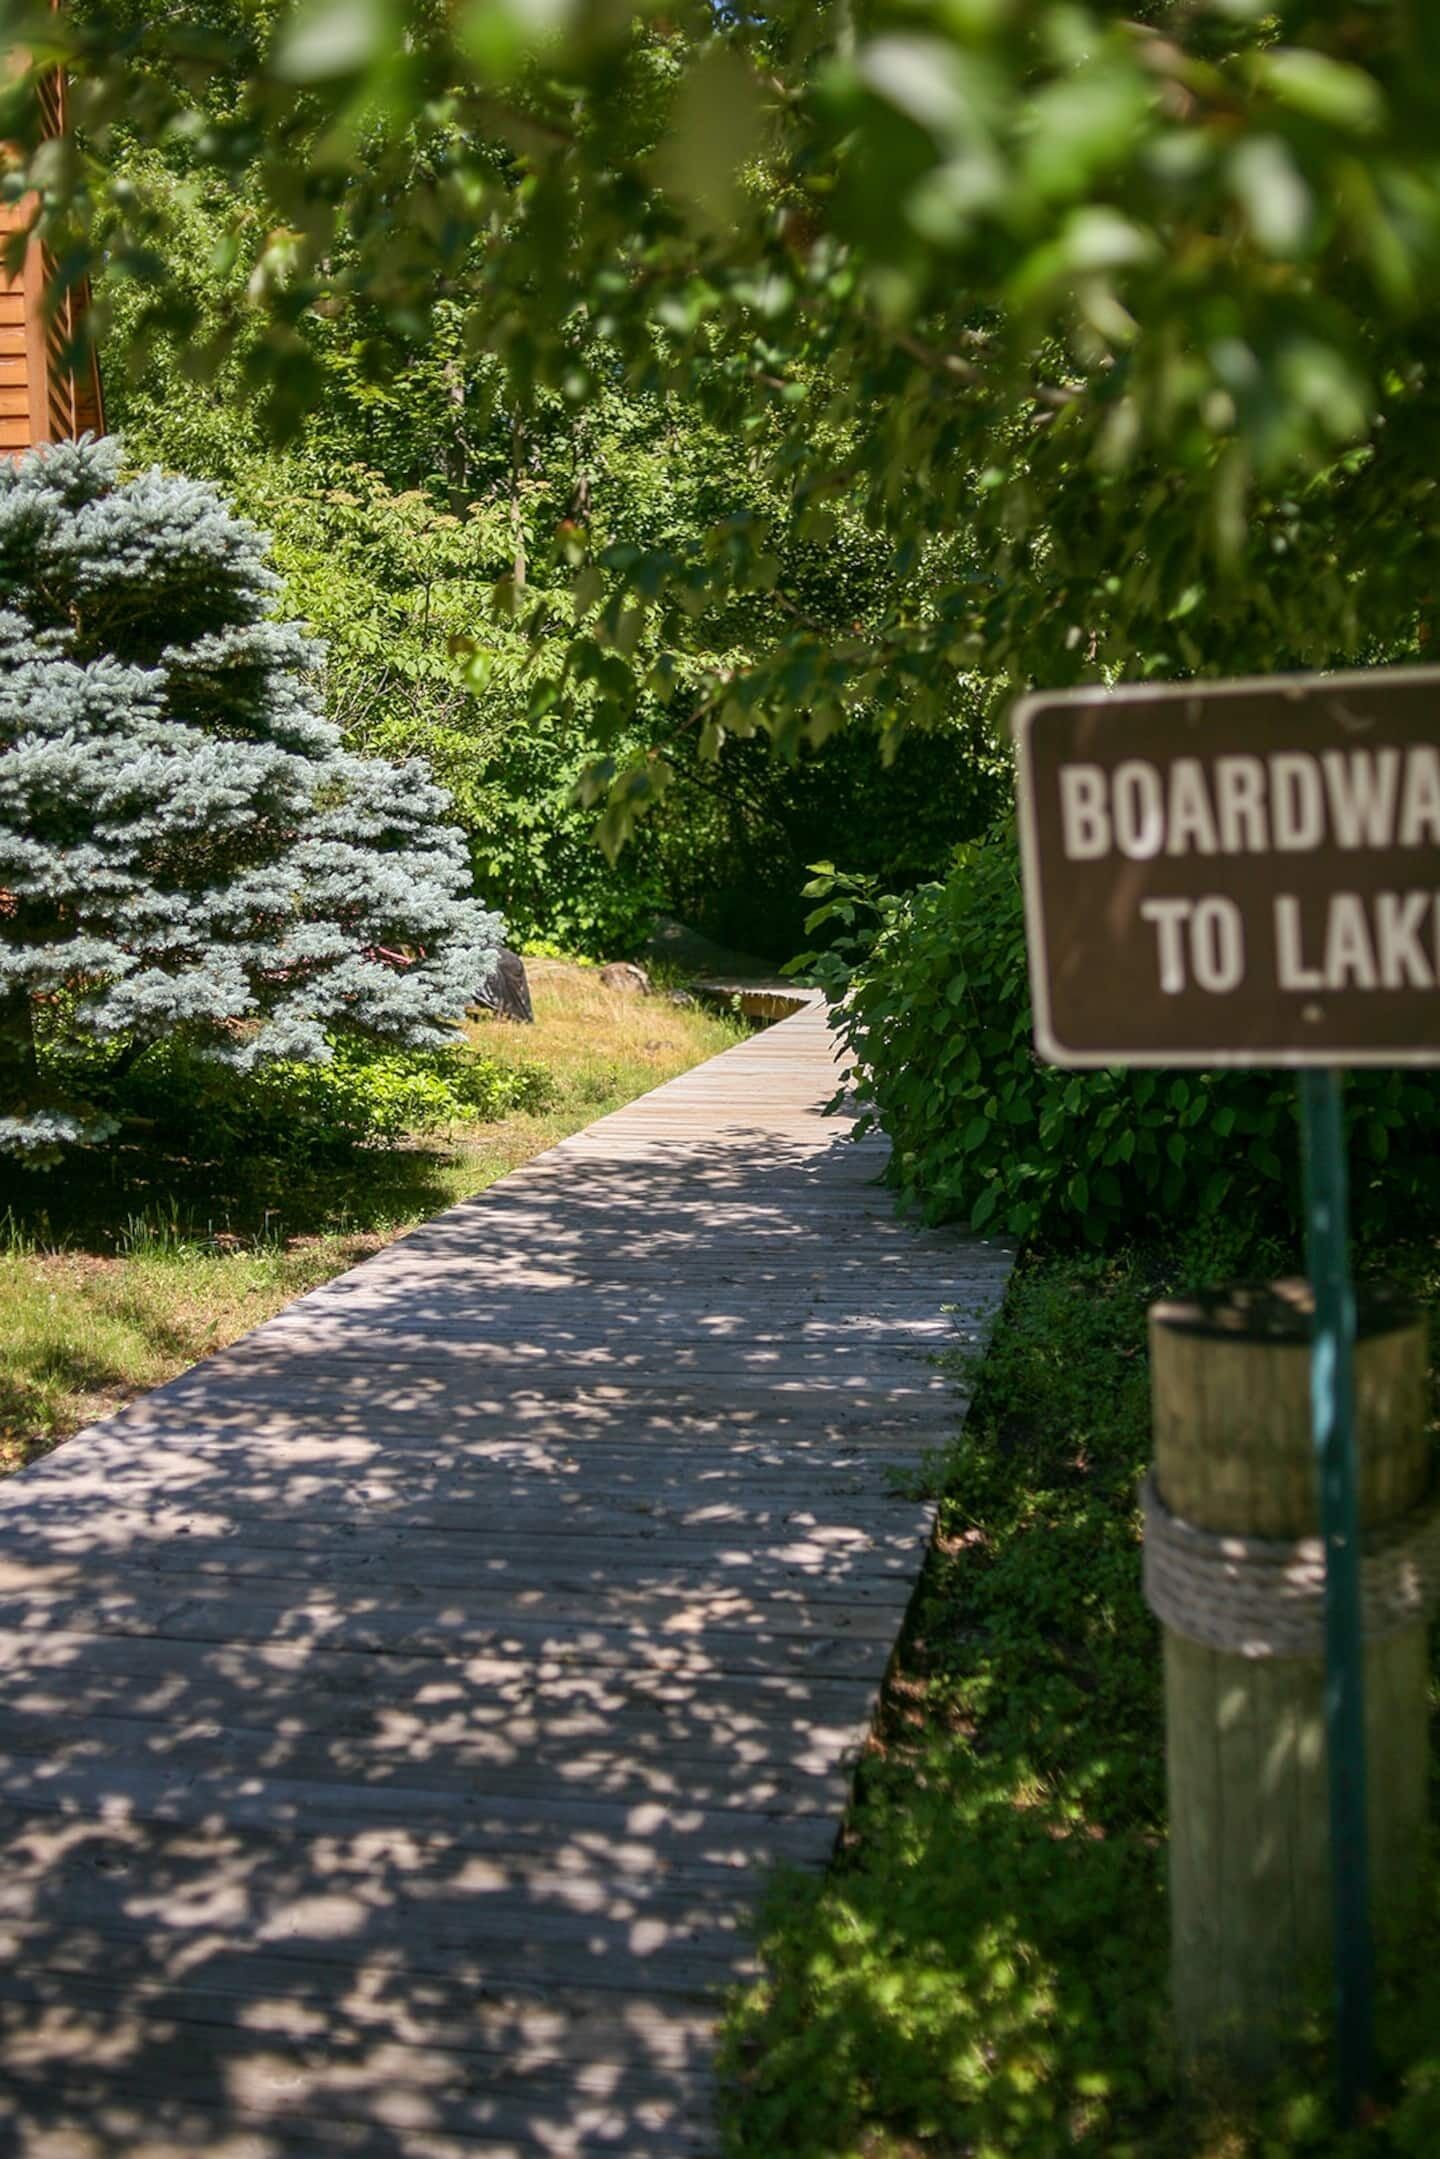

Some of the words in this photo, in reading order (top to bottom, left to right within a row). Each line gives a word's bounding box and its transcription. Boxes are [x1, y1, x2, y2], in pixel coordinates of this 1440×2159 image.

[1059, 745, 1440, 860] BOARDWA
[1140, 895, 1244, 994] TO
[1274, 892, 1440, 991] LAK
